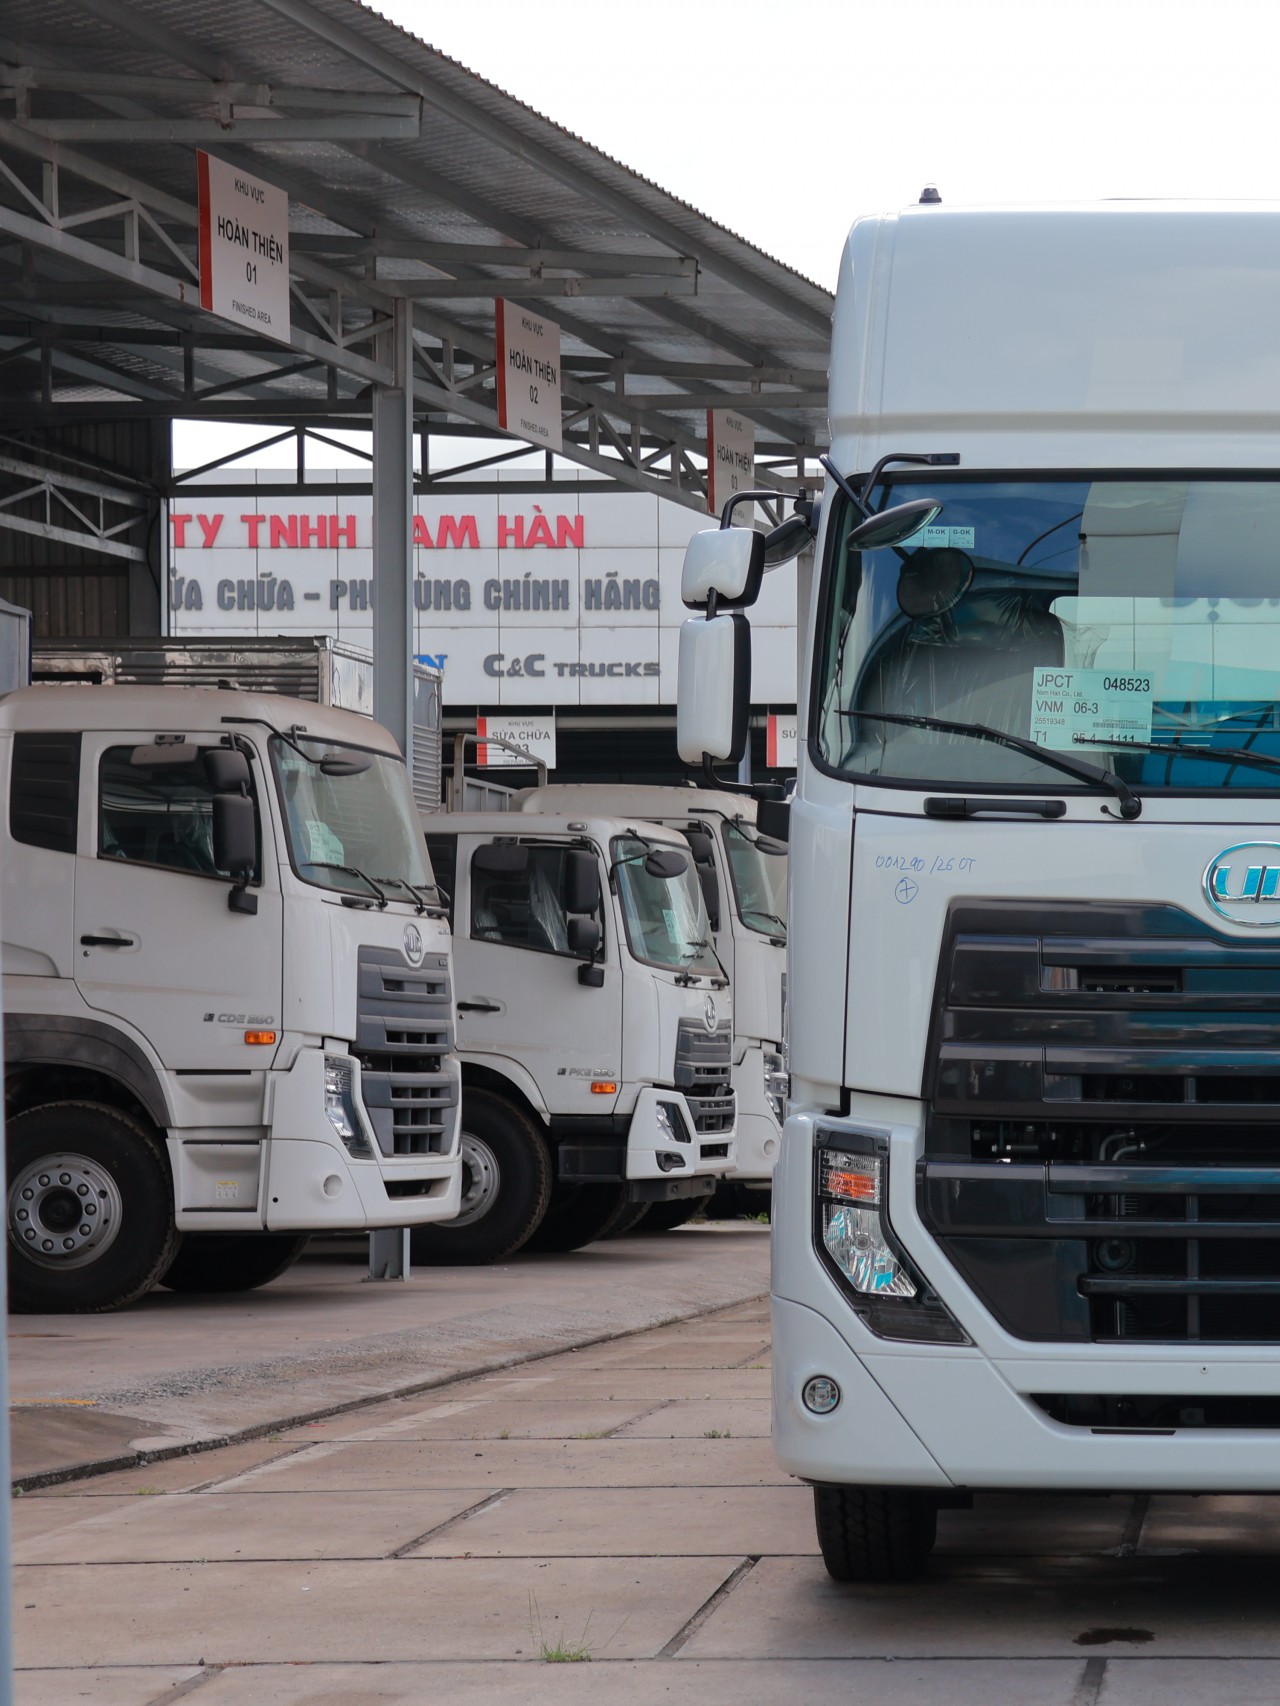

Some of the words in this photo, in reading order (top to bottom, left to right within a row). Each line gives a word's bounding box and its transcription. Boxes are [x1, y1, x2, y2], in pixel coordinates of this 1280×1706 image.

[234, 178, 249, 196] KHU
[250, 186, 265, 204] VỰC
[217, 215, 249, 249] HOÀN
[252, 231, 283, 265] THIỆN
[246, 262, 257, 285] 01
[232, 300, 256, 319] FINISHED
[257, 310, 272, 325] AREA
[509, 348, 532, 375] HOÀN
[534, 359, 556, 387] THIỆN
[529, 385, 539, 404] 02
[170, 514, 224, 548] TY
[240, 514, 356, 548] TNHH
[497, 505, 584, 548] HÀN
[170, 566, 203, 610] ỬA
[217, 572, 295, 610] CHỮA
[413, 572, 471, 611] ÙNG
[483, 572, 569, 611] CHÍNH
[584, 572, 660, 610] HÃNG
[483, 654, 545, 677] C&C
[553, 662, 660, 677] TRUCKS
[1037, 674, 1074, 688] JPCT
[1103, 677, 1150, 692] 048523
[1036, 700, 1064, 713] VNM
[1074, 702, 1098, 714] 06-3
[492, 729, 516, 740] SỬA
[518, 729, 551, 740] CHỮA
[1034, 731, 1048, 742] T1
